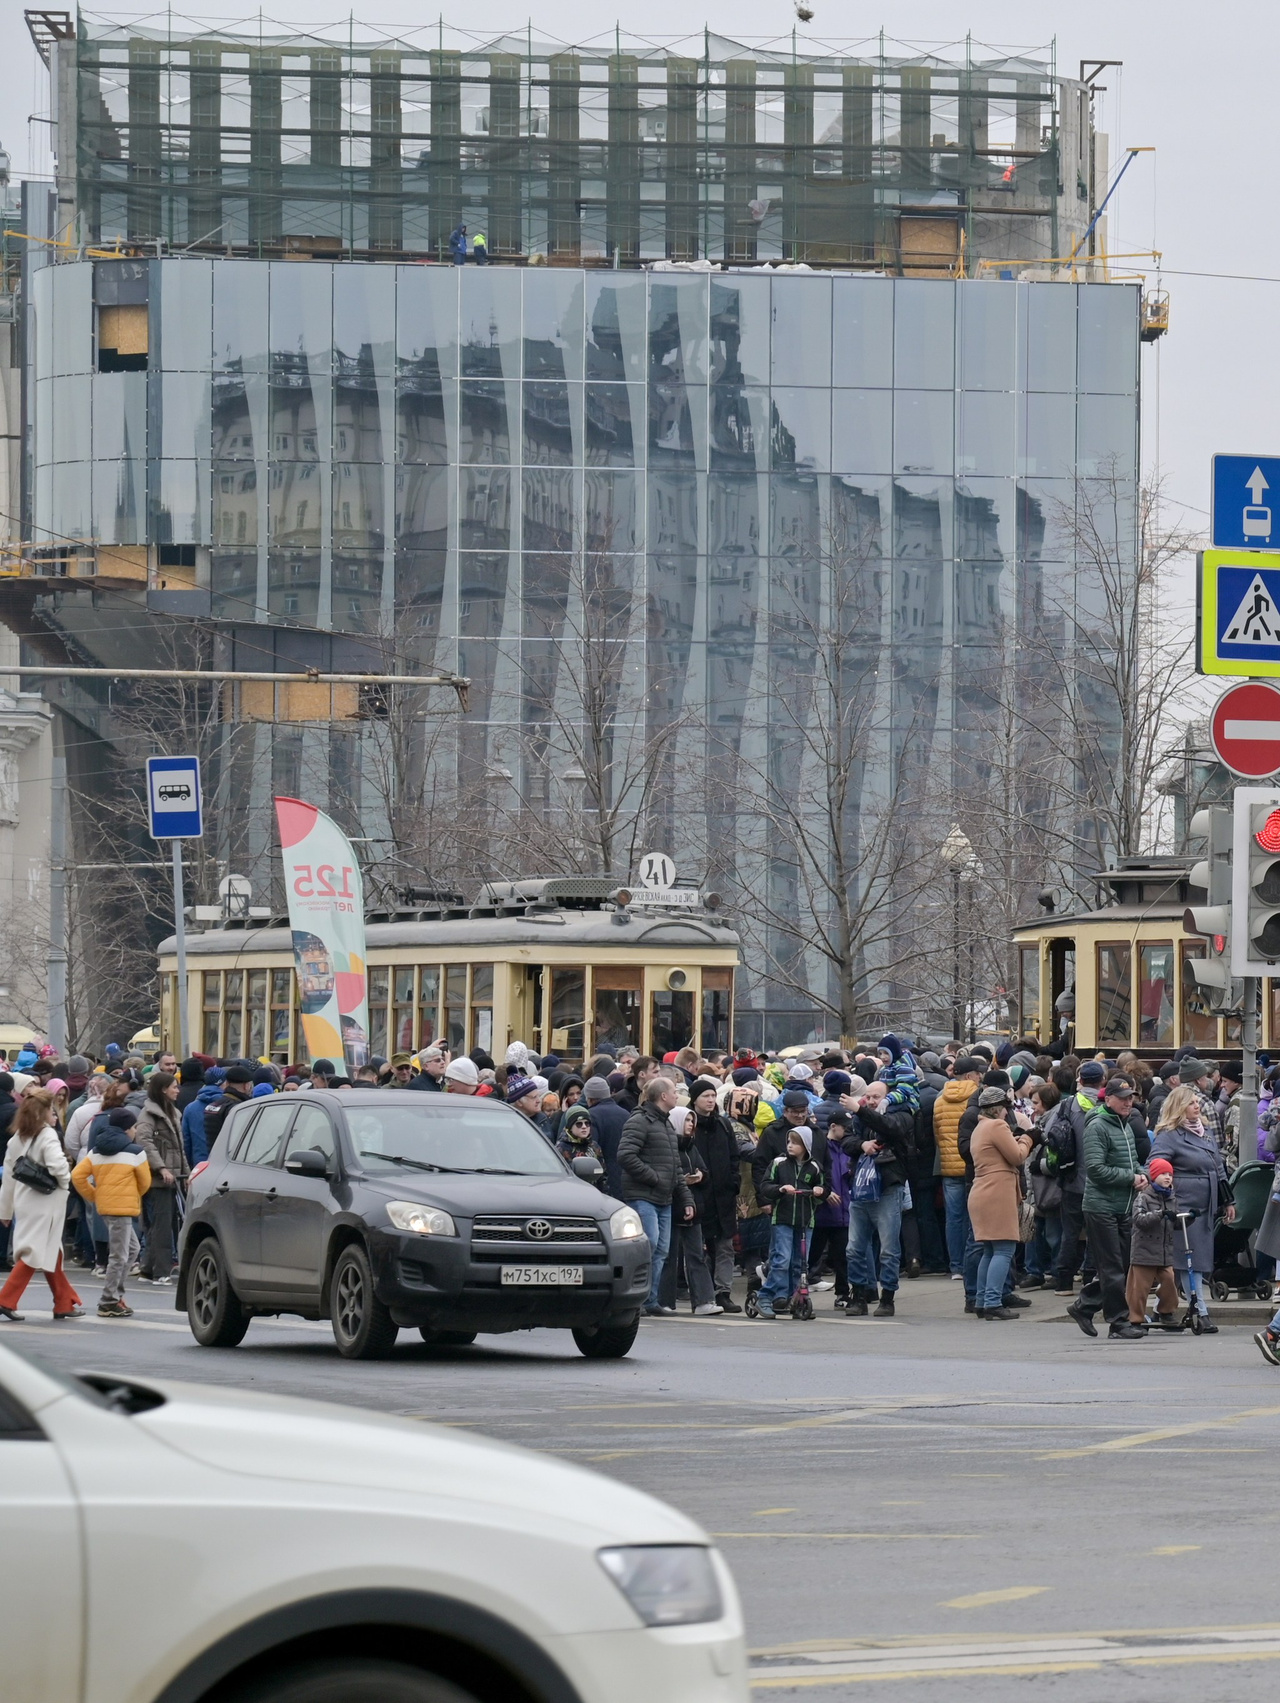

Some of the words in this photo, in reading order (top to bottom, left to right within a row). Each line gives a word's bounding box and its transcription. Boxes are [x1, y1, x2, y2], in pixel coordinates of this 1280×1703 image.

[645, 858, 668, 885] 41
[505, 1268, 557, 1283] М751ХС
[560, 1268, 579, 1279] 197
